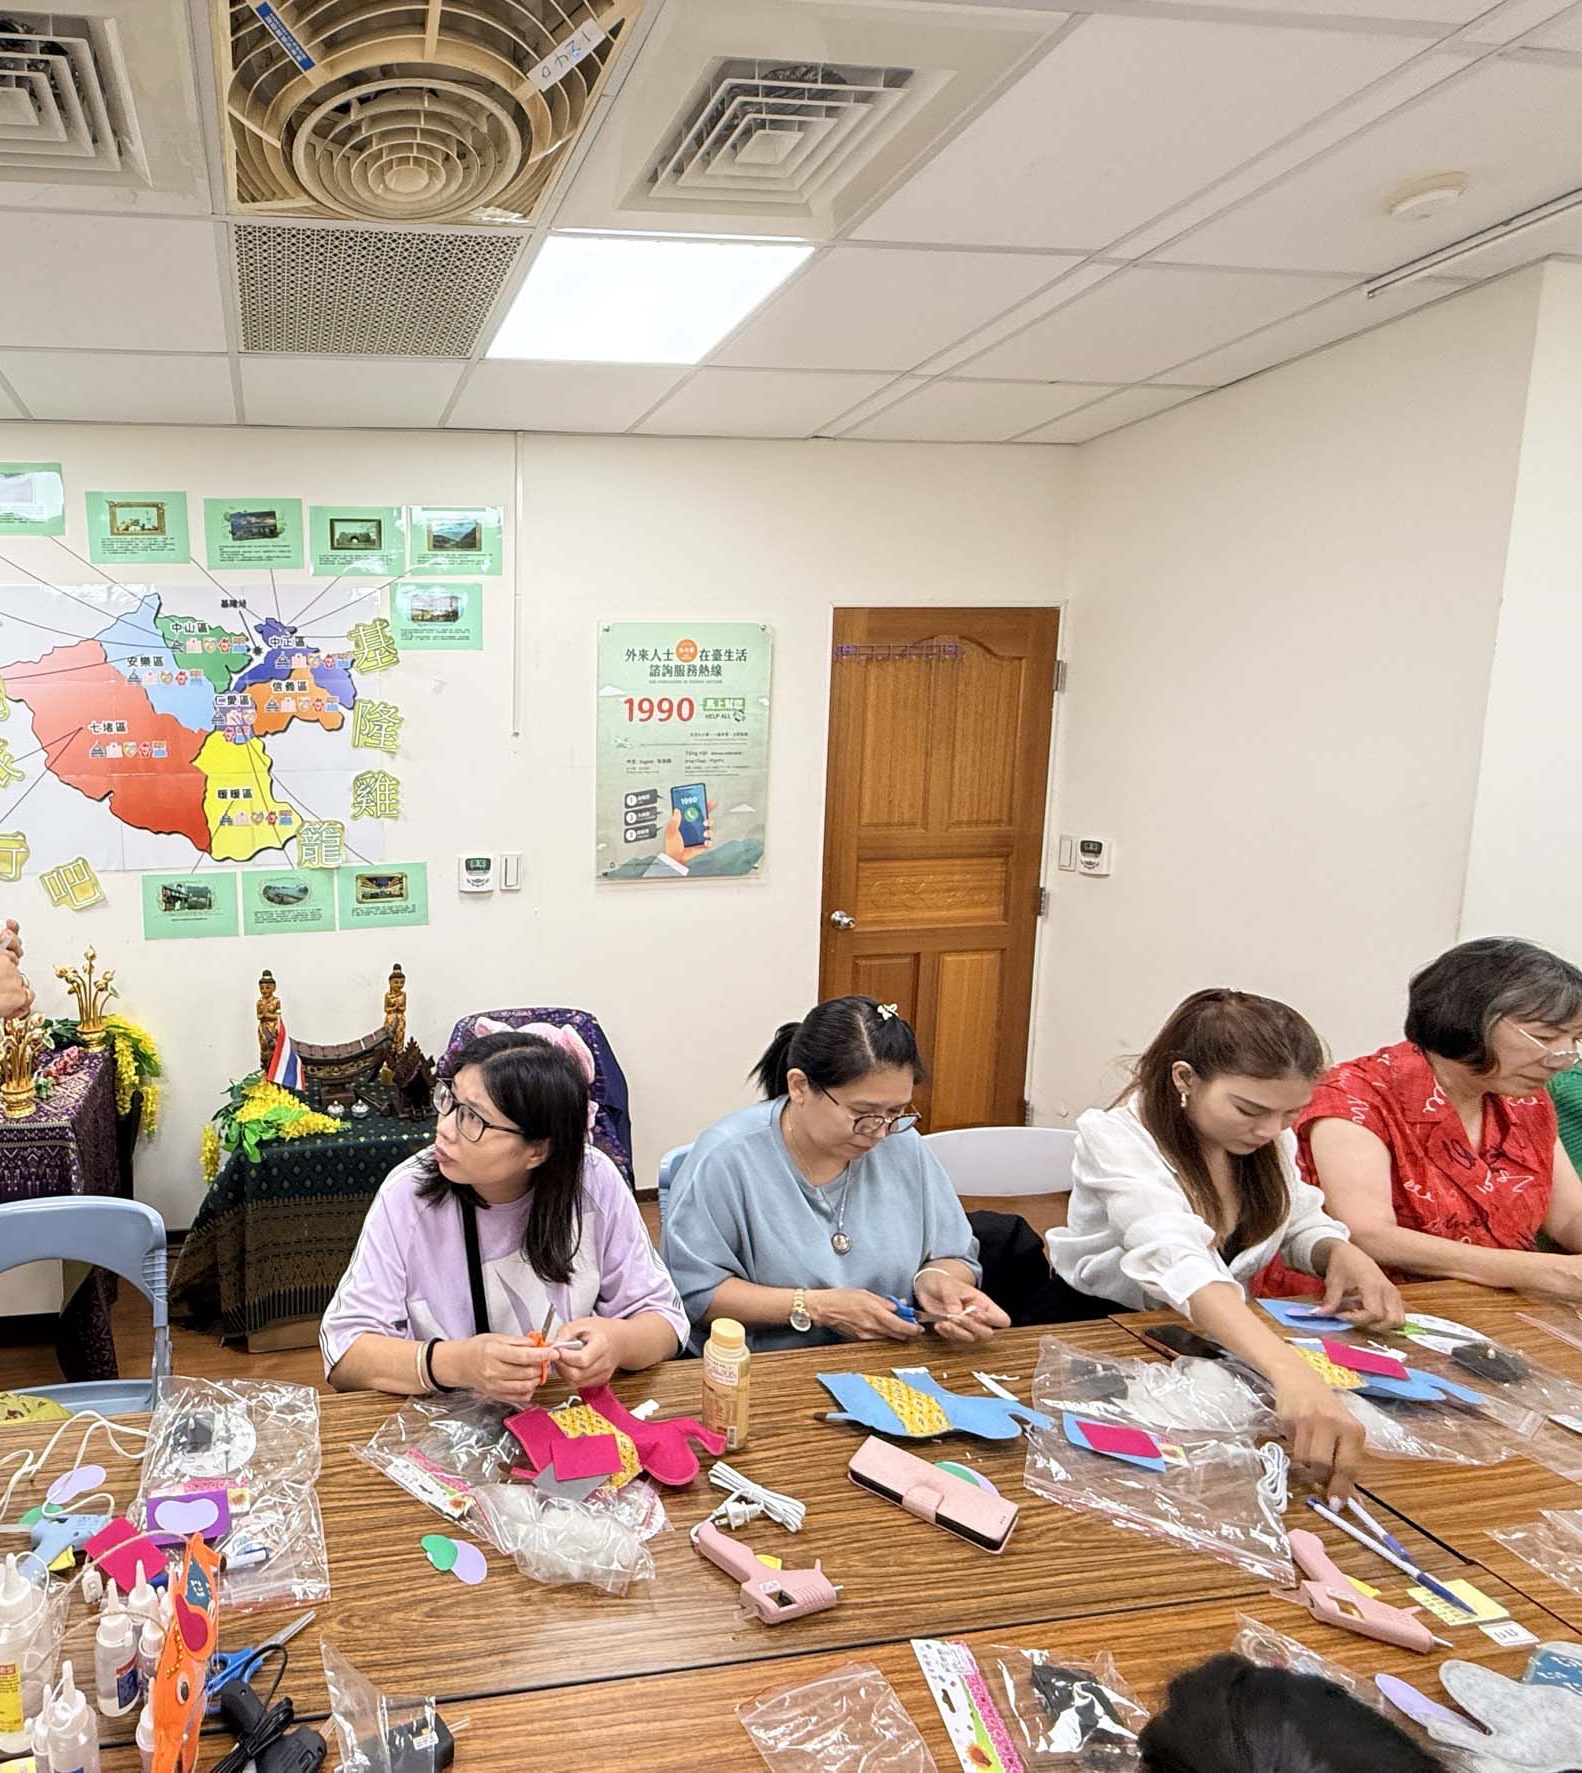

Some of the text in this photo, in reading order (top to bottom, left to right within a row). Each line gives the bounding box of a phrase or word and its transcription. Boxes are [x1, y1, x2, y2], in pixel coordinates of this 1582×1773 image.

[171, 622, 209, 635] 中山區
[269, 636, 306, 648] 中正區
[126, 655, 165, 668] 安樂區
[625, 648, 674, 662] 外來人士
[699, 648, 748, 662] 在臺生活
[649, 663, 723, 678] 諮詢服務熱線
[272, 681, 309, 693] 信義區
[214, 694, 250, 707] 仁愛區
[623, 697, 695, 722] 1990
[218, 788, 254, 800] 暖暖區
